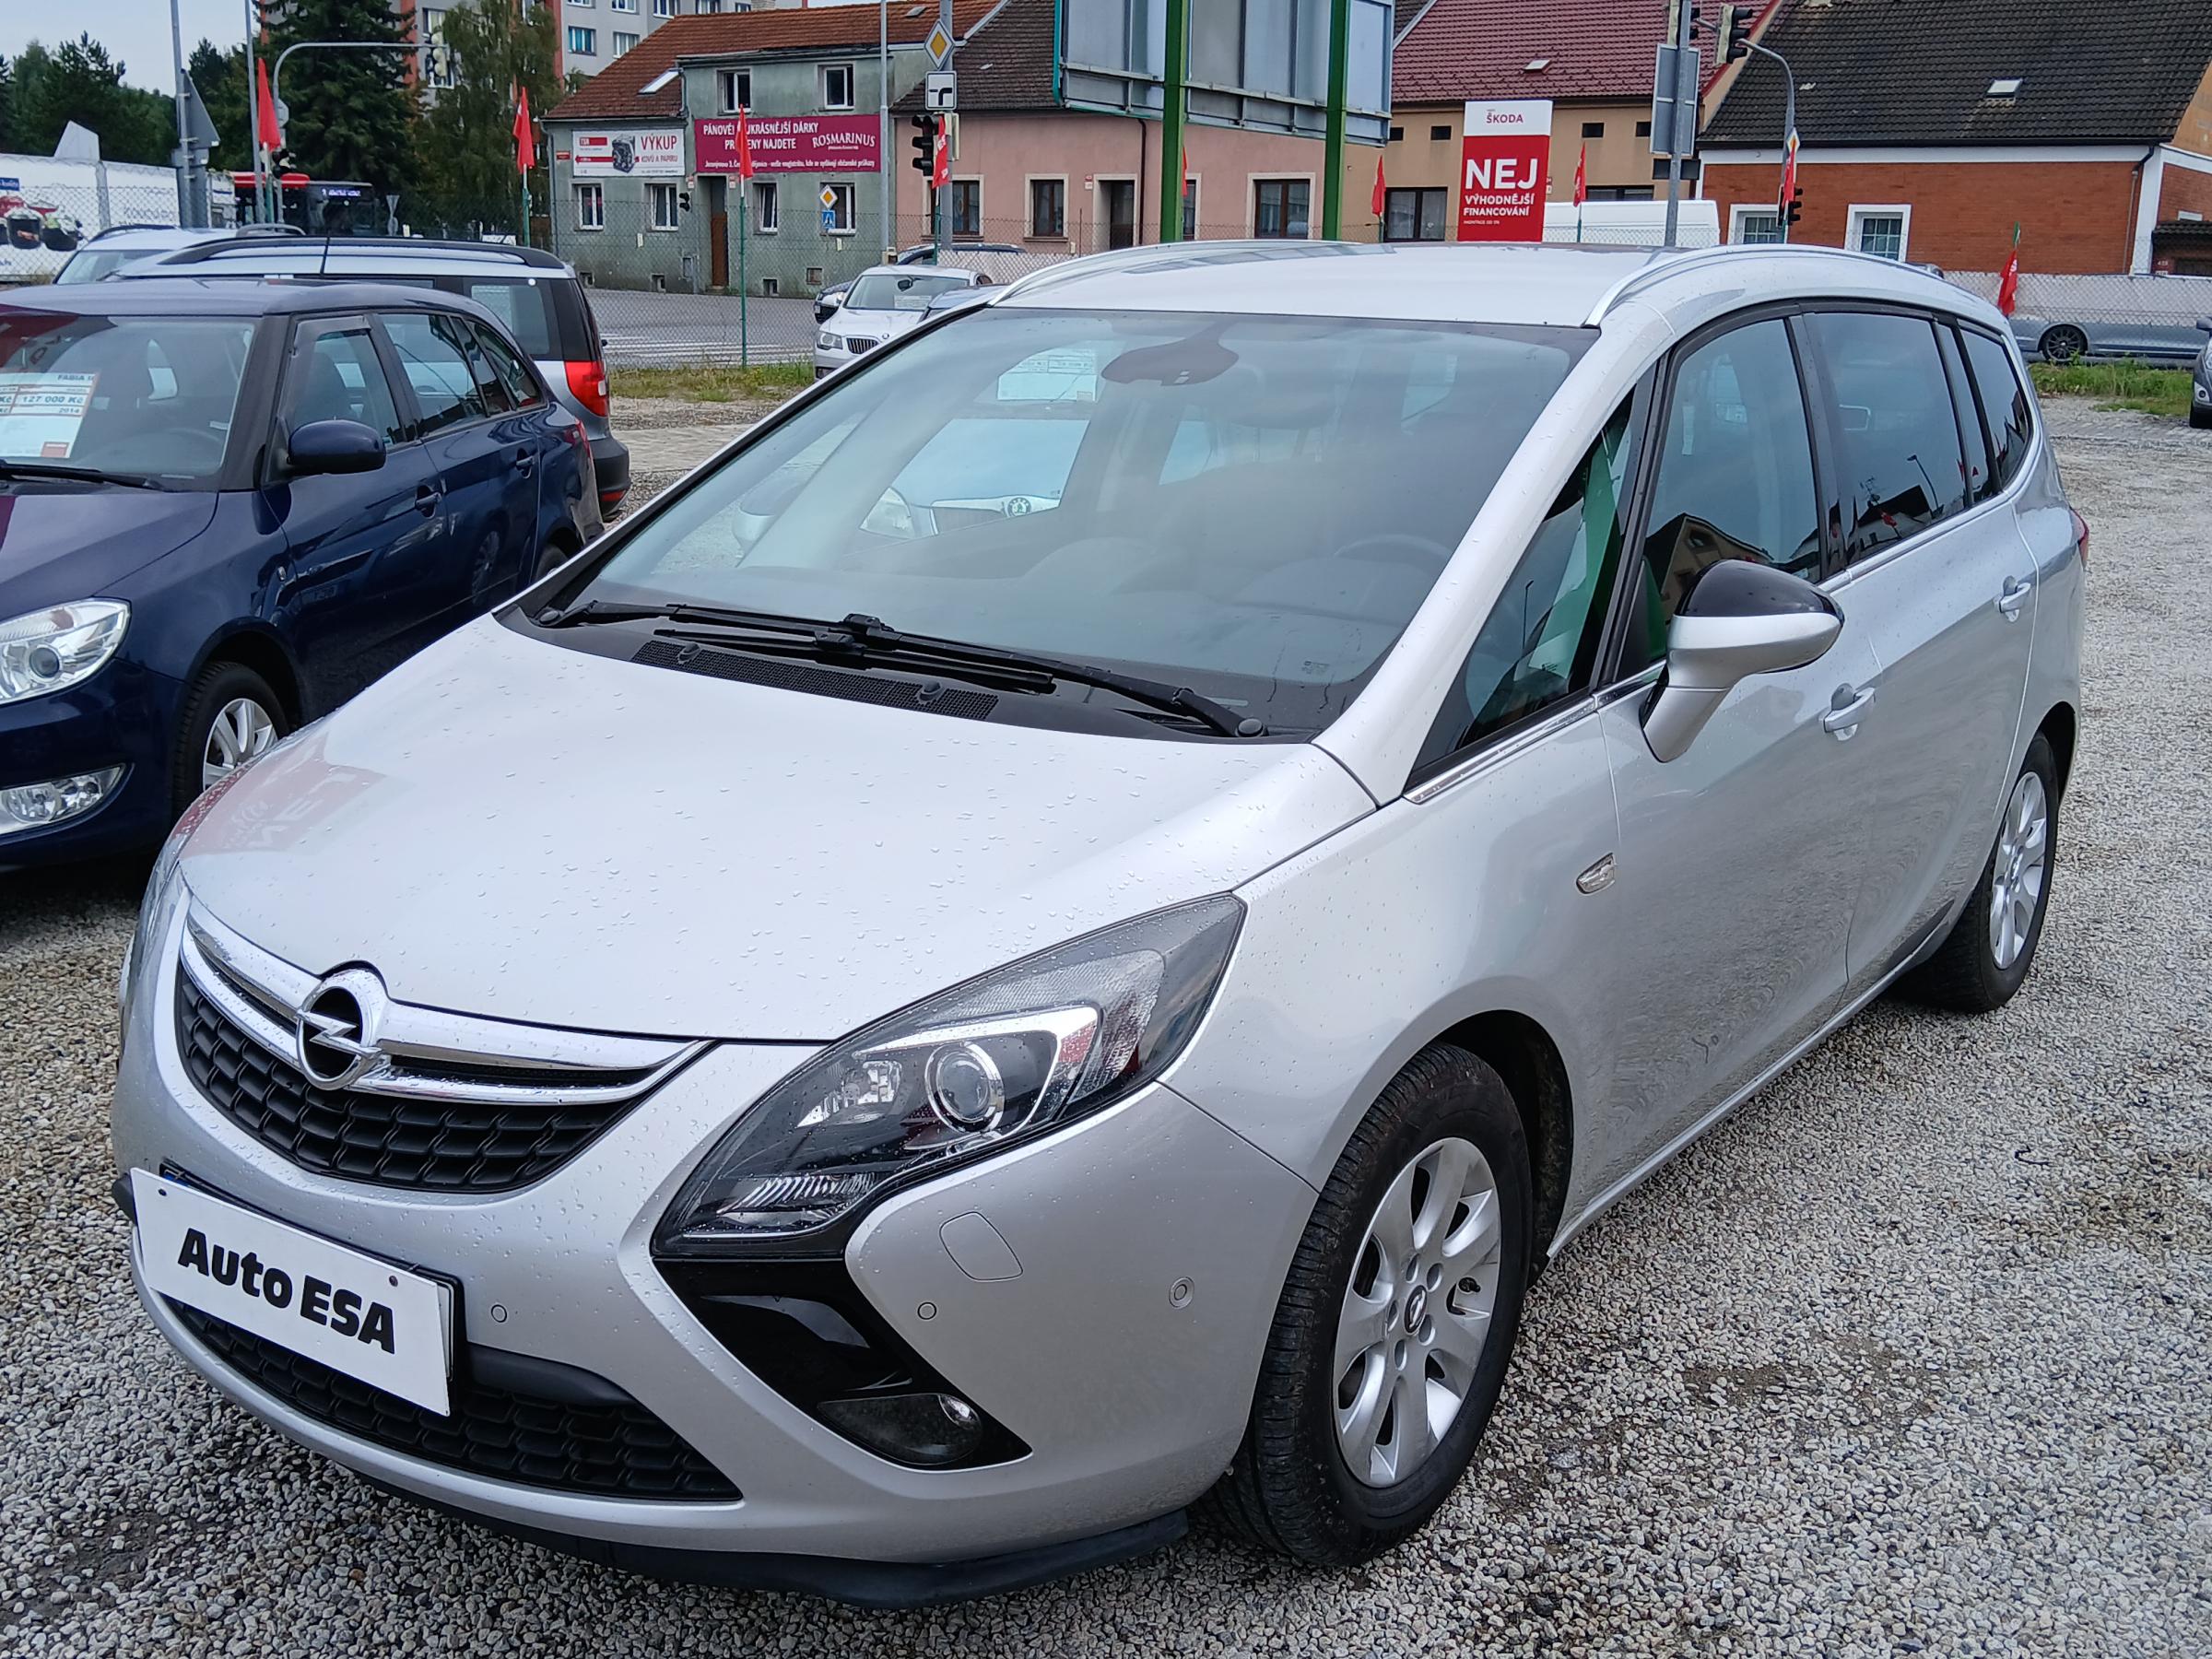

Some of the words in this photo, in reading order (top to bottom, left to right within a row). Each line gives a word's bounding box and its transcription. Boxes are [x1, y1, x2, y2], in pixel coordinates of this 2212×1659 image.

[1486, 112, 1524, 124] ŠKODA
[737, 121, 791, 135] JKRÁSNĚJŠÍ
[793, 121, 818, 134] DÁRKY
[641, 133, 677, 150] VÝKUP
[763, 138, 796, 149] NAJDETE
[812, 133, 876, 147] ROSMARINUS
[1465, 159, 1538, 190] NEJ
[1465, 193, 1535, 205] VÝHODNĚJŠÍ
[1464, 206, 1529, 216] FINANCOVÁNÍ
[178, 1228, 293, 1309] Auto
[300, 1275, 395, 1355] ESA
